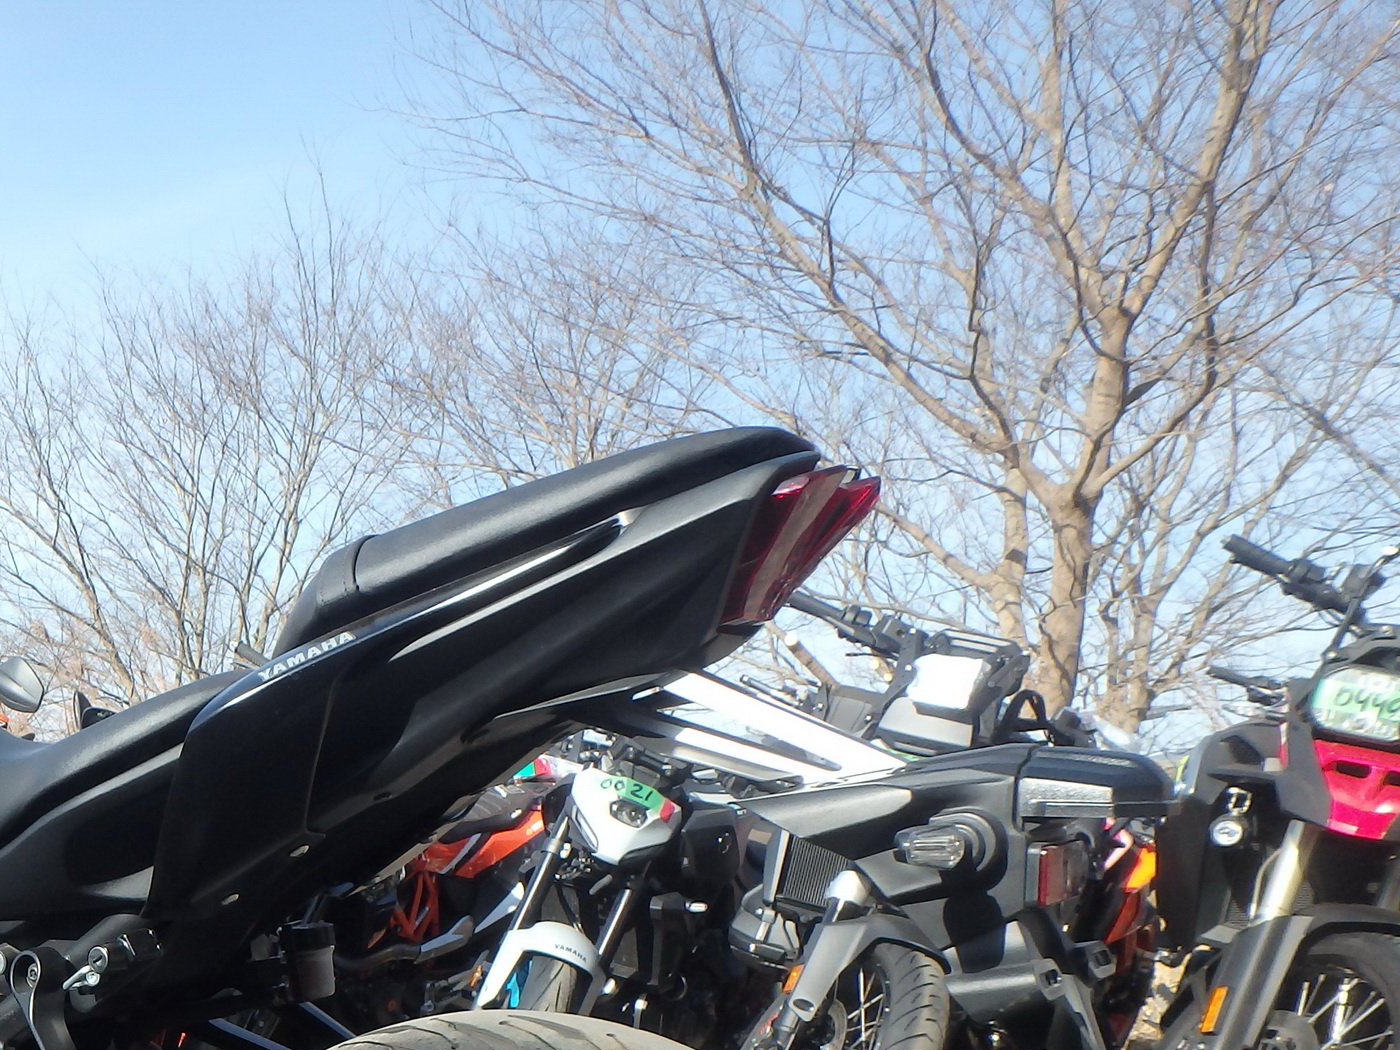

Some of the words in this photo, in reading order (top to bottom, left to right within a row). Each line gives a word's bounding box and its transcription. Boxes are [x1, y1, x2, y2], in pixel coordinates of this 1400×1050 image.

[257, 631, 357, 682] YAMAHA
[600, 779, 653, 801] 0021
[554, 943, 587, 963] YAMAHA
